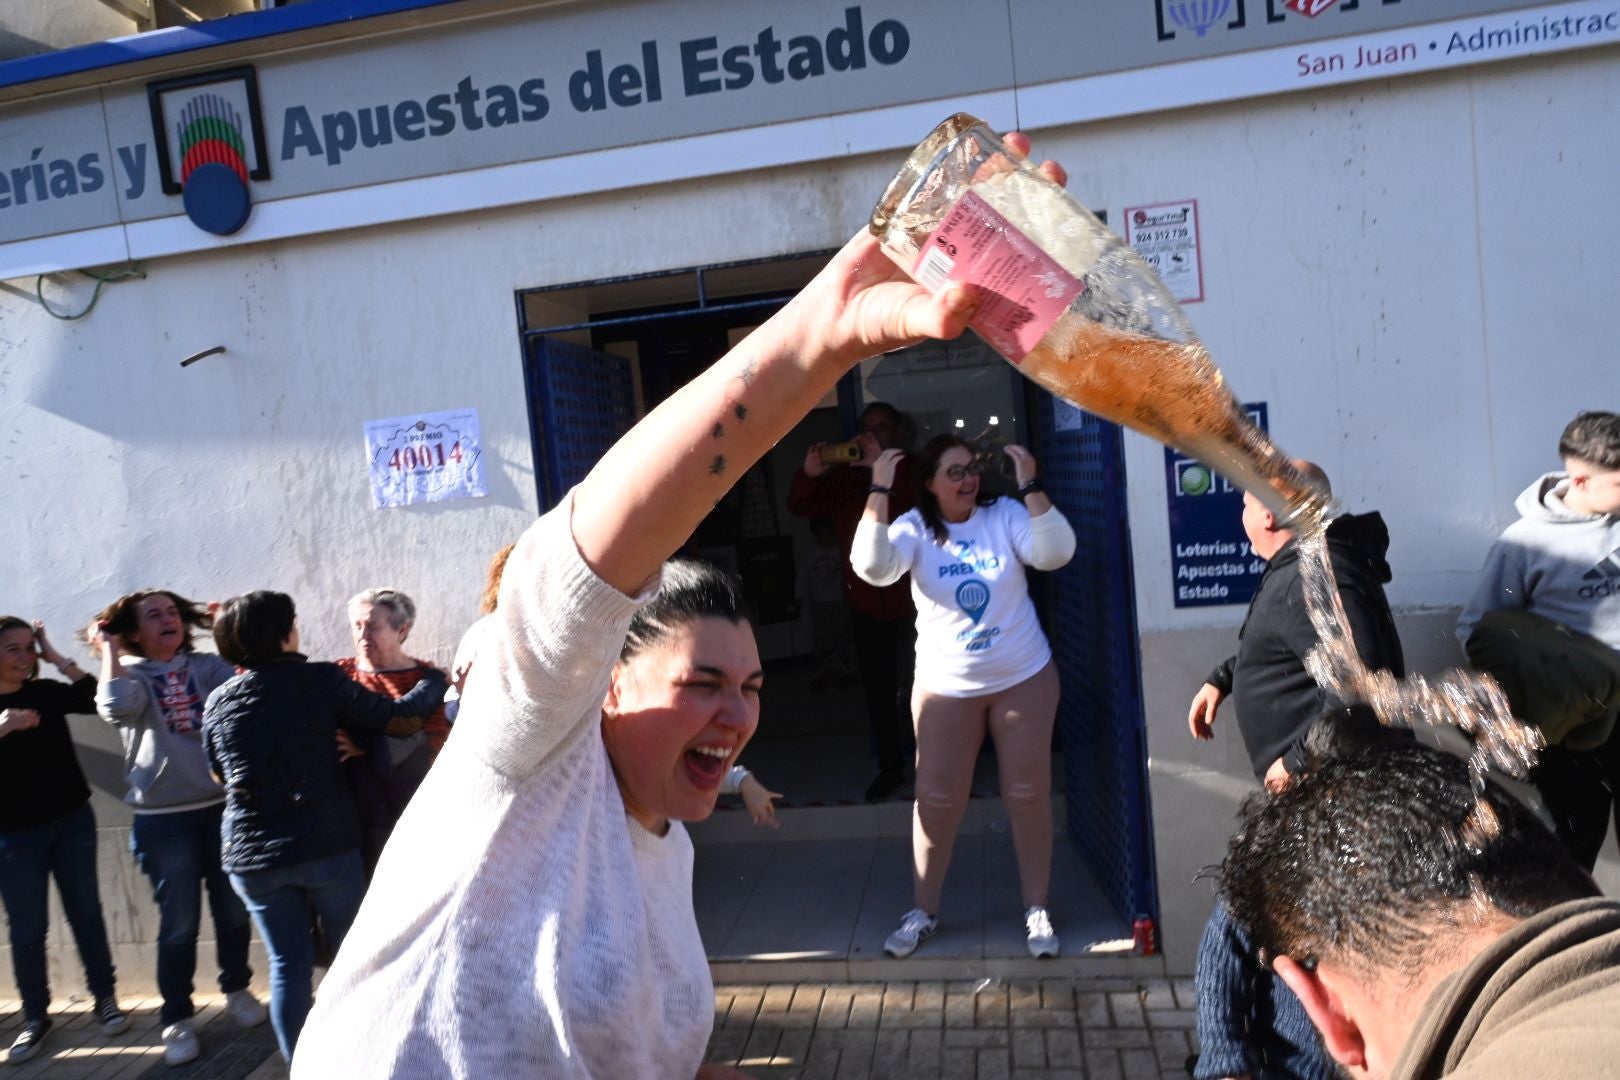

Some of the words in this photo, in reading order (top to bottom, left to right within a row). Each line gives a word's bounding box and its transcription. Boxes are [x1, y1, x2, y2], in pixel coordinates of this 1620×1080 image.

[1297, 53, 1344, 77] San
[1354, 43, 1416, 69] Juan
[117, 143, 147, 200] y
[280, 76, 550, 166] Apuestas
[568, 41, 662, 112] del
[680, 6, 911, 97] Estado
[388, 440, 463, 472] 40014
[1176, 540, 1237, 558] Loterías
[1241, 541, 1249, 557] y
[939, 556, 999, 578] PREMIO
[1178, 562, 1245, 581] Apuestas
[1179, 583, 1229, 599] Estado
[1577, 577, 1620, 600] adi
